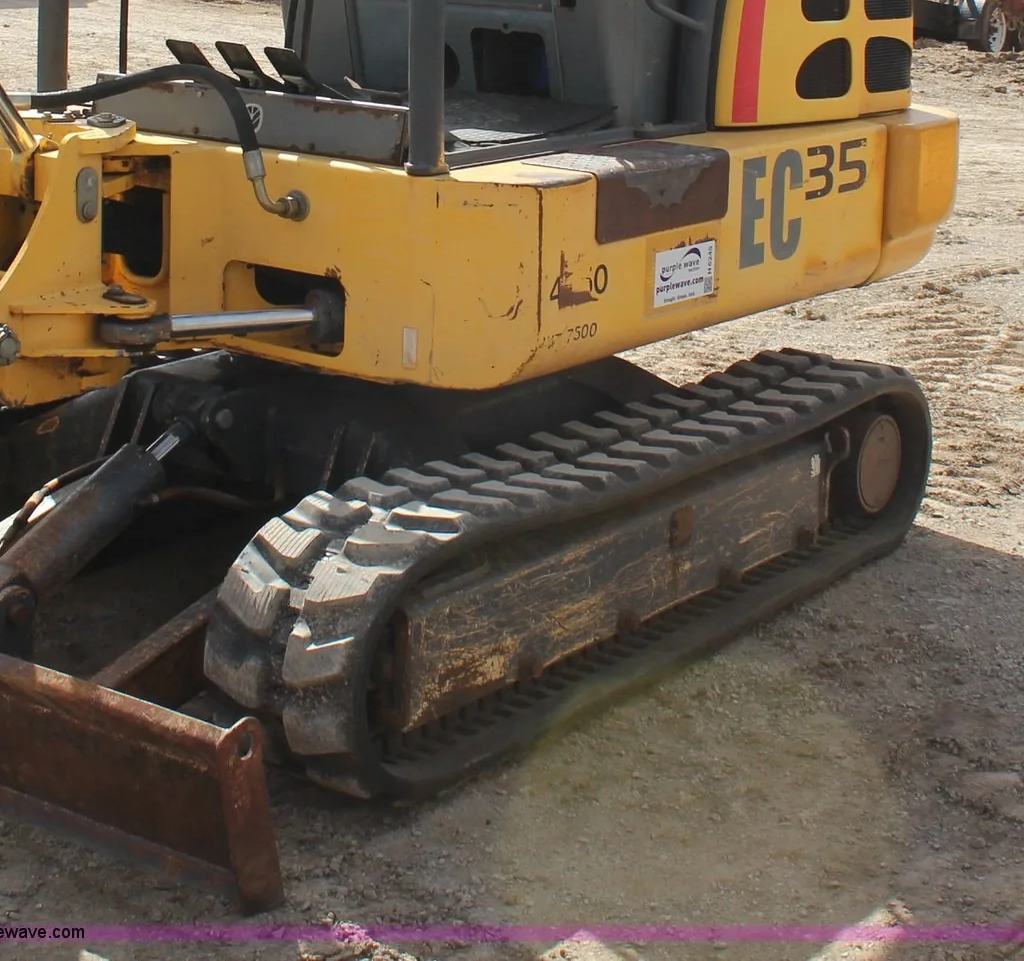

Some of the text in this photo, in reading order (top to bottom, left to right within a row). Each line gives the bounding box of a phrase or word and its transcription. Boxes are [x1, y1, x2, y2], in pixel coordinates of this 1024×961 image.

[661, 261, 682, 274] purple
[683, 258, 700, 268] wave
[655, 276, 704, 295] purplewave.com
